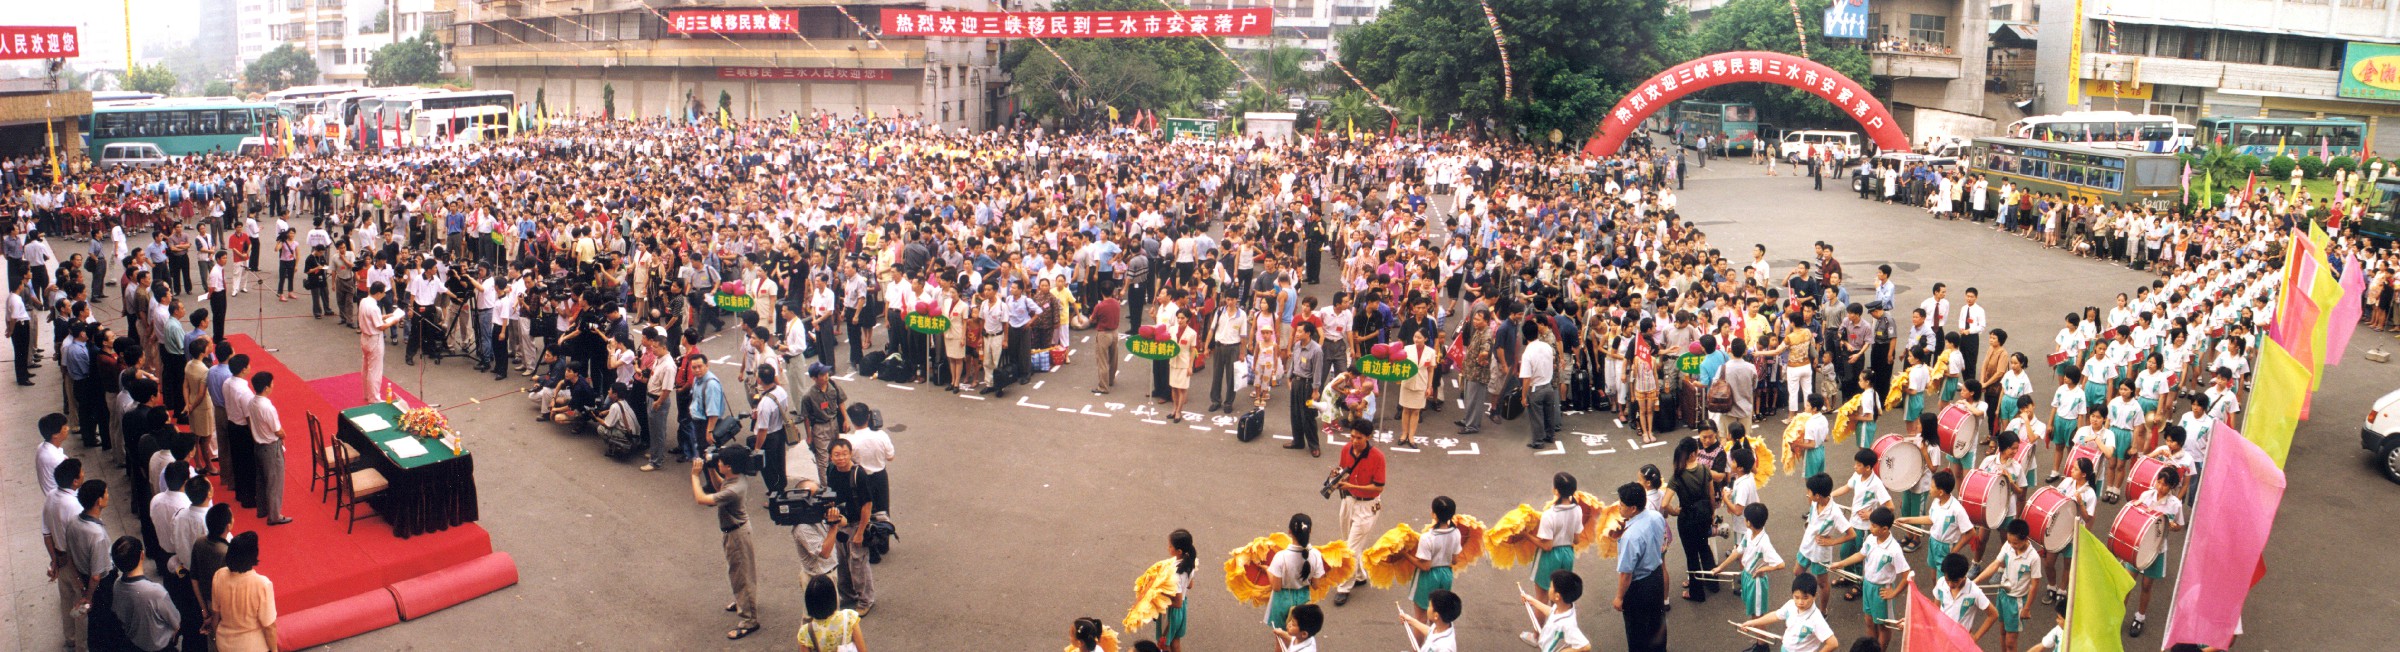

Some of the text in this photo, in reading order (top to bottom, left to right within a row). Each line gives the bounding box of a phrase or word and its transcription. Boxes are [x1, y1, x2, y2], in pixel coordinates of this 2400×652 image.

[896, 13, 1257, 35] 热烈欢迎三峡移民到三水市安家落户
[724, 68, 772, 77] 三峡移民
[1615, 57, 1884, 131] 热烈欢迎三峡移民到三水市安家落户
